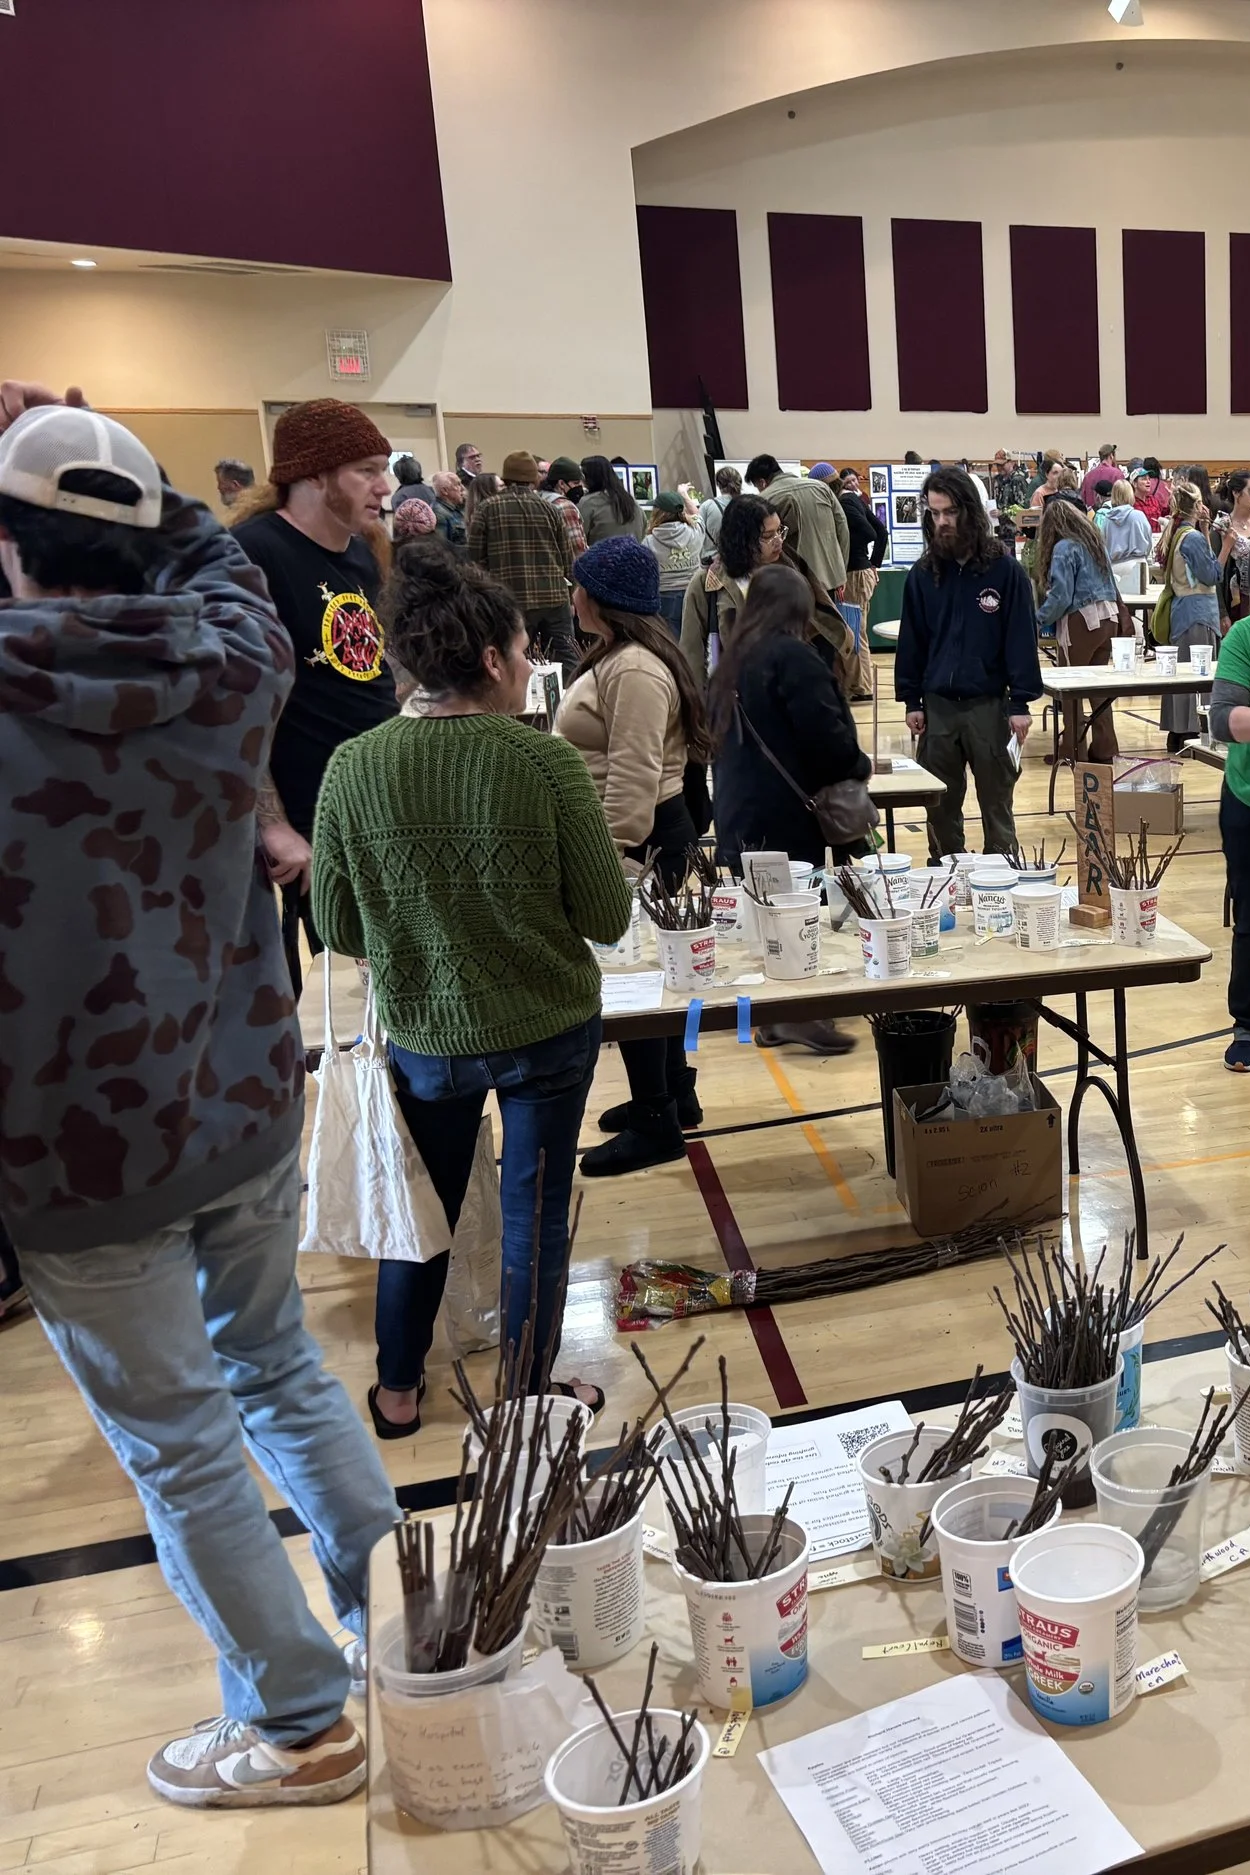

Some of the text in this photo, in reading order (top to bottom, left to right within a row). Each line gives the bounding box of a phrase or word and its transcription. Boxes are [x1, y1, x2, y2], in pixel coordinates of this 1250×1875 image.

[1083, 772, 1103, 897] PEAR
[1010, 1159, 1031, 1176] #2
[957, 1178, 998, 1200] Scion
[827, 1531, 872, 1548] ootstock
[1229, 1548, 1249, 1563] CA
[954, 1571, 969, 1583] 100%
[1022, 1629, 1060, 1652] ORGANIC
[1027, 1669, 1063, 1691] GREEK
[1045, 1668, 1065, 1680] Milk
[1148, 1675, 1164, 1688] CA
